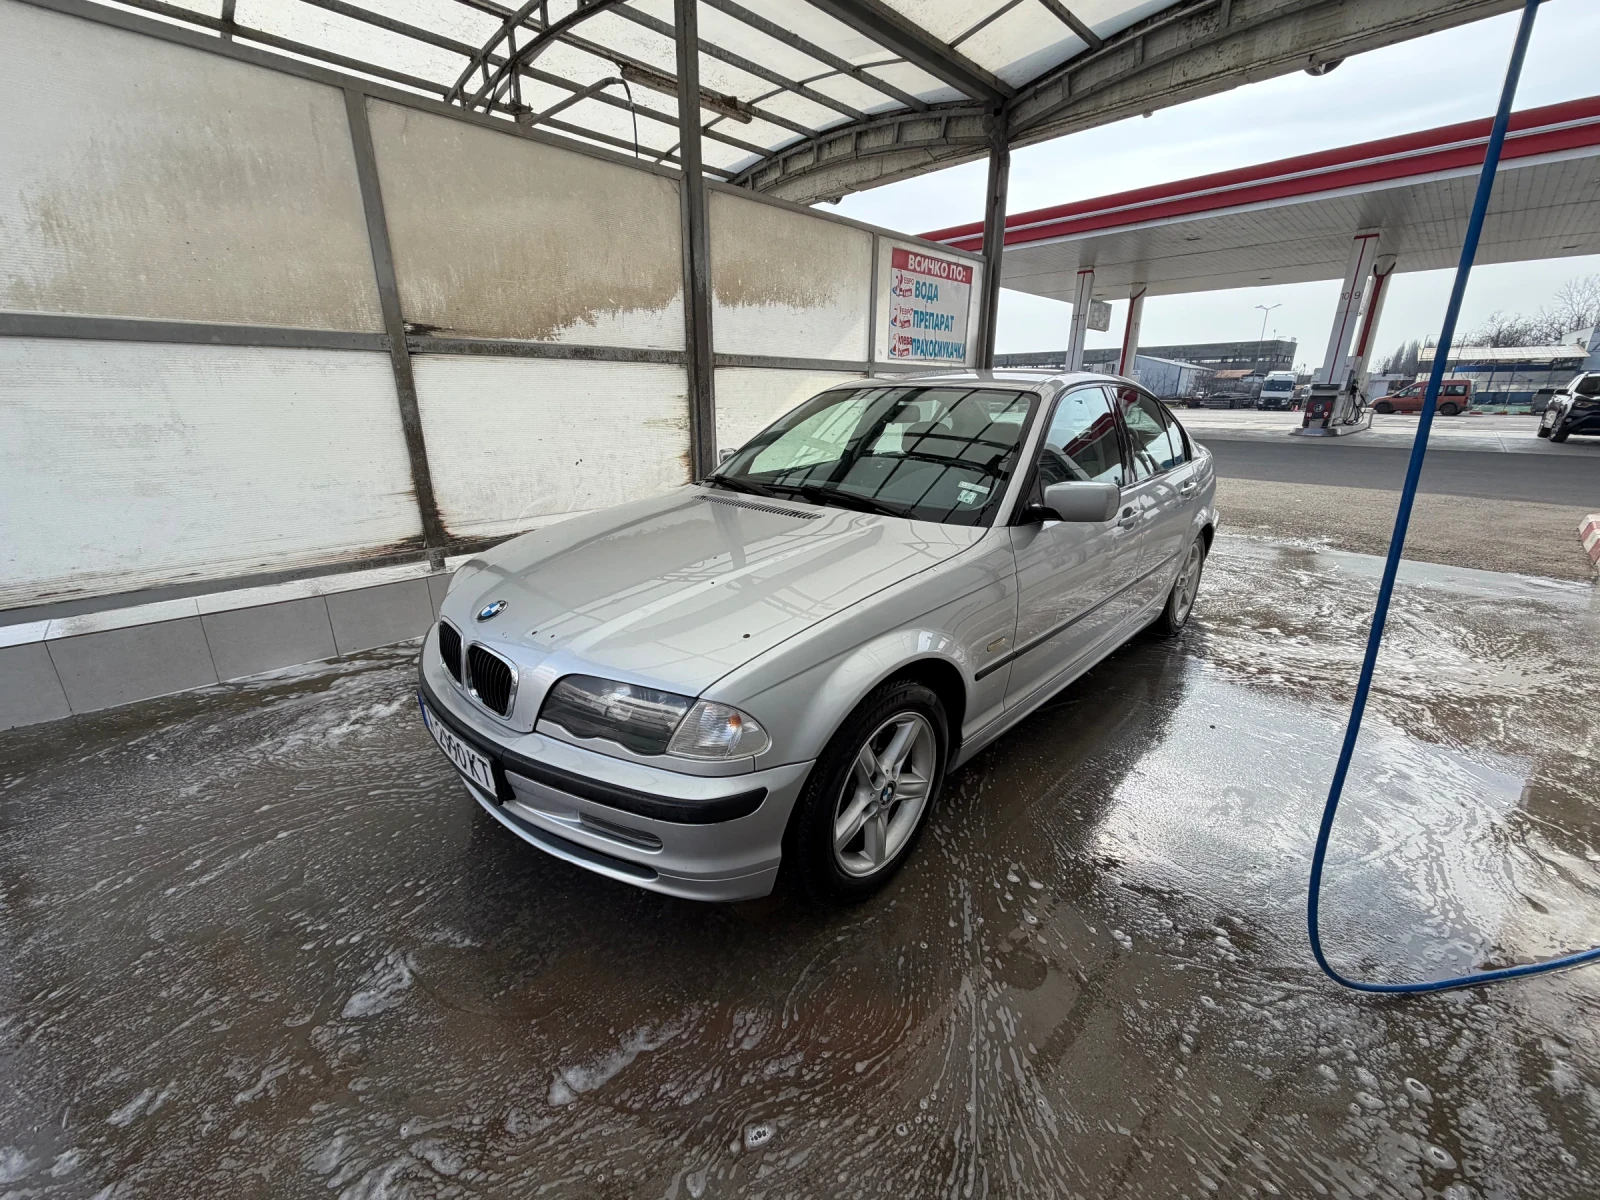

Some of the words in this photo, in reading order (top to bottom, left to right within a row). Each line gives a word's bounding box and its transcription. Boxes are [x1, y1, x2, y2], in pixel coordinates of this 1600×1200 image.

[908, 254, 949, 277] ВСИЧКО
[950, 264, 966, 282] ПО:
[914, 280, 939, 304] ВОДА
[1341, 292, 1350, 300] 10
[1354, 291, 1361, 299] 9
[913, 309, 955, 333] ПРЕПАРАТ
